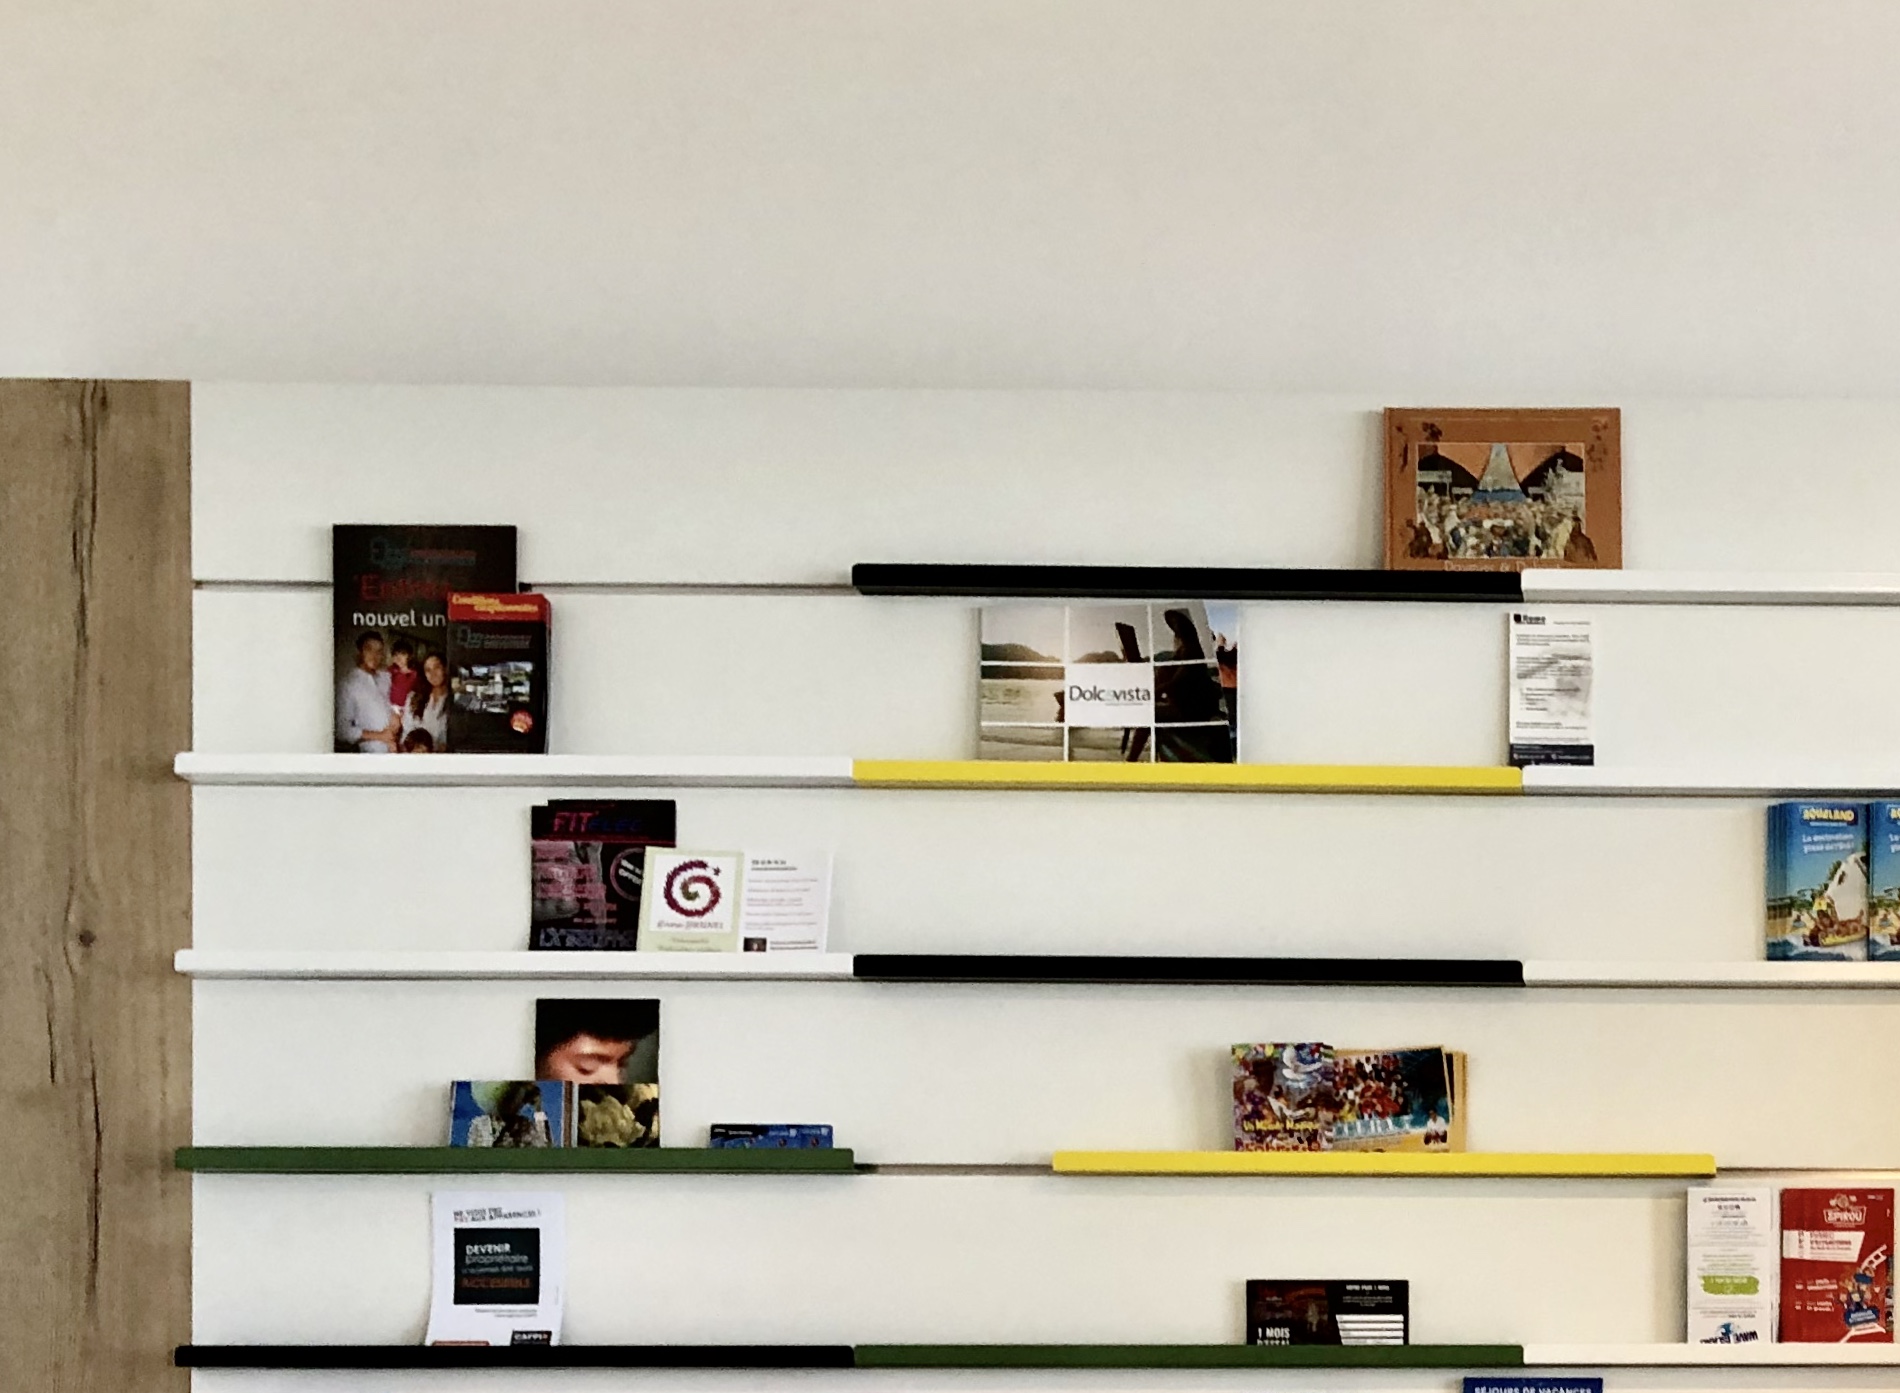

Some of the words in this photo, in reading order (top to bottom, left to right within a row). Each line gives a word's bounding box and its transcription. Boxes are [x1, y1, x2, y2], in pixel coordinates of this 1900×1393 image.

[353, 609, 416, 627] nouvel
[465, 1242, 511, 1255] DEVENIR
[1266, 1327, 1290, 1339] MOIS
